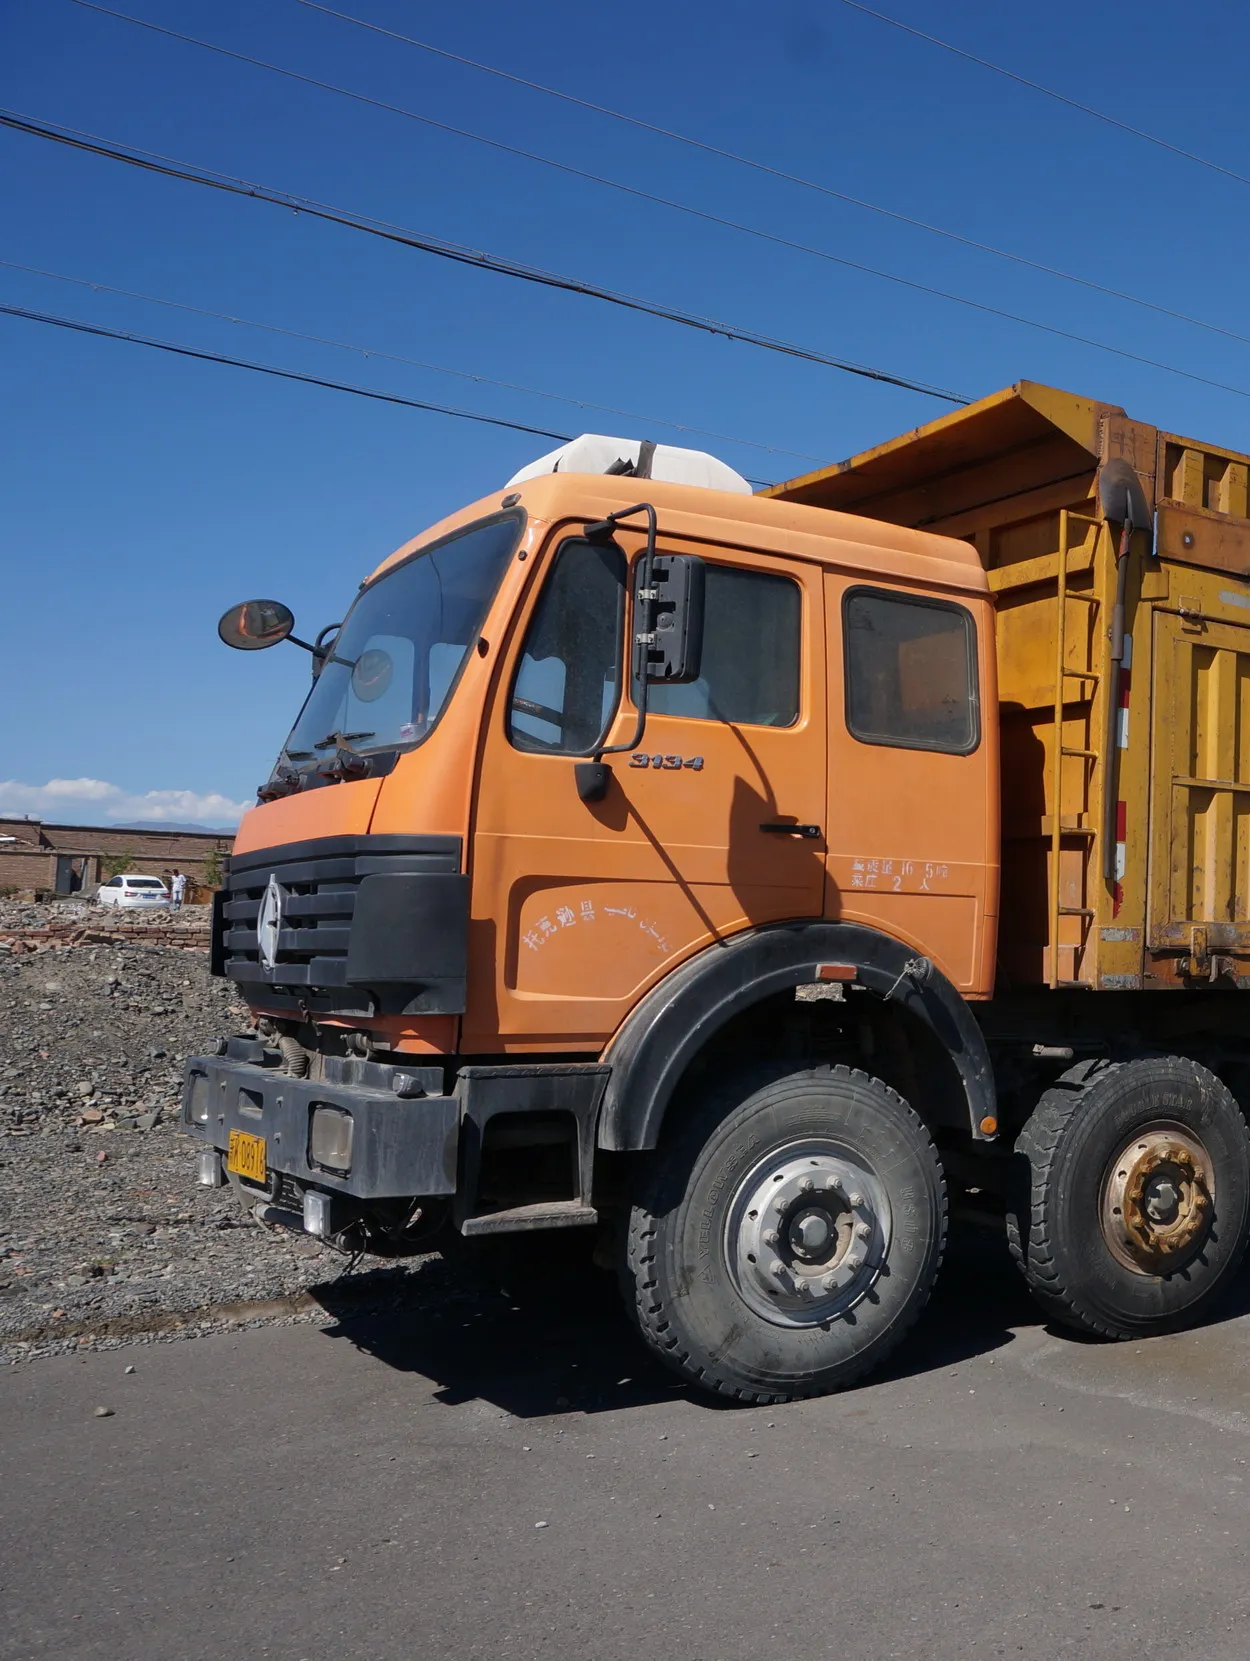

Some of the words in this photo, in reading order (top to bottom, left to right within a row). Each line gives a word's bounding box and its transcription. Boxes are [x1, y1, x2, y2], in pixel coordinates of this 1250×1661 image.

[628, 752, 704, 772] 3134
[893, 875, 902, 892] 2
[919, 878, 930, 891] 人
